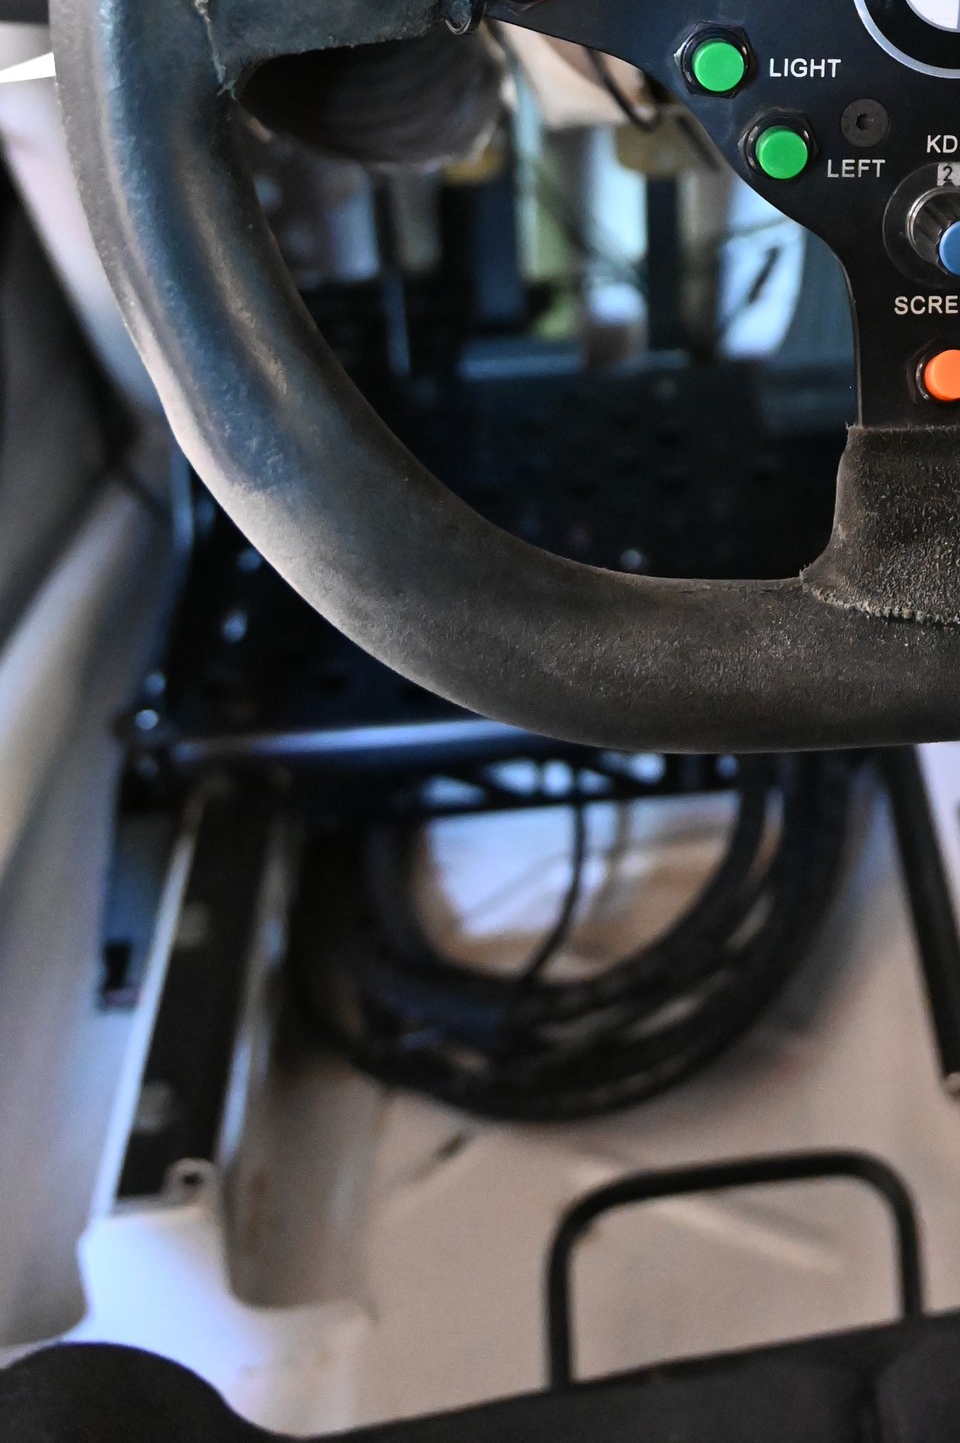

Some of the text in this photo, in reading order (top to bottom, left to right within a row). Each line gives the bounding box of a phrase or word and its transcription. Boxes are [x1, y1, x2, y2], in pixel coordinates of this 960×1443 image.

[769, 57, 842, 78] LIGHT
[827, 159, 886, 178] LEFT
[942, 165, 953, 181] 2
